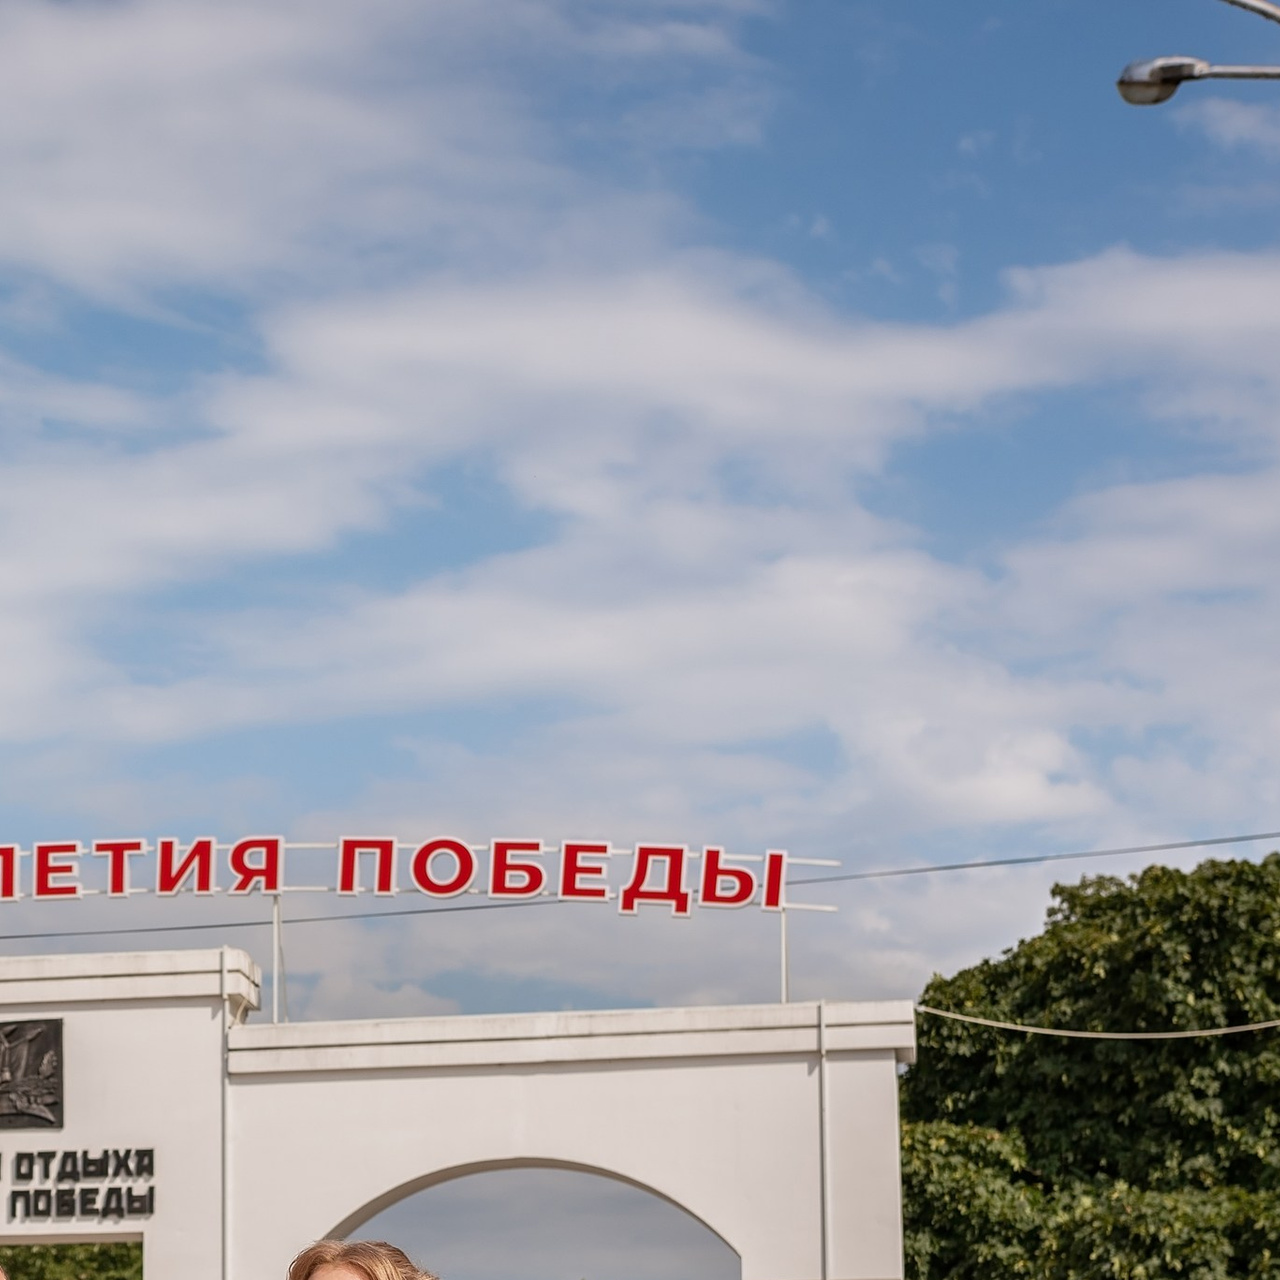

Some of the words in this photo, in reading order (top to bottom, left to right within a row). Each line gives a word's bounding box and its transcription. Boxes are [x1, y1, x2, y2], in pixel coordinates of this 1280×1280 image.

[337, 836, 787, 916] ПОБЕДЫ
[15, 1148, 155, 1183] ОТДЫХА
[10, 1186, 155, 1220] ПОБЕДЫ
